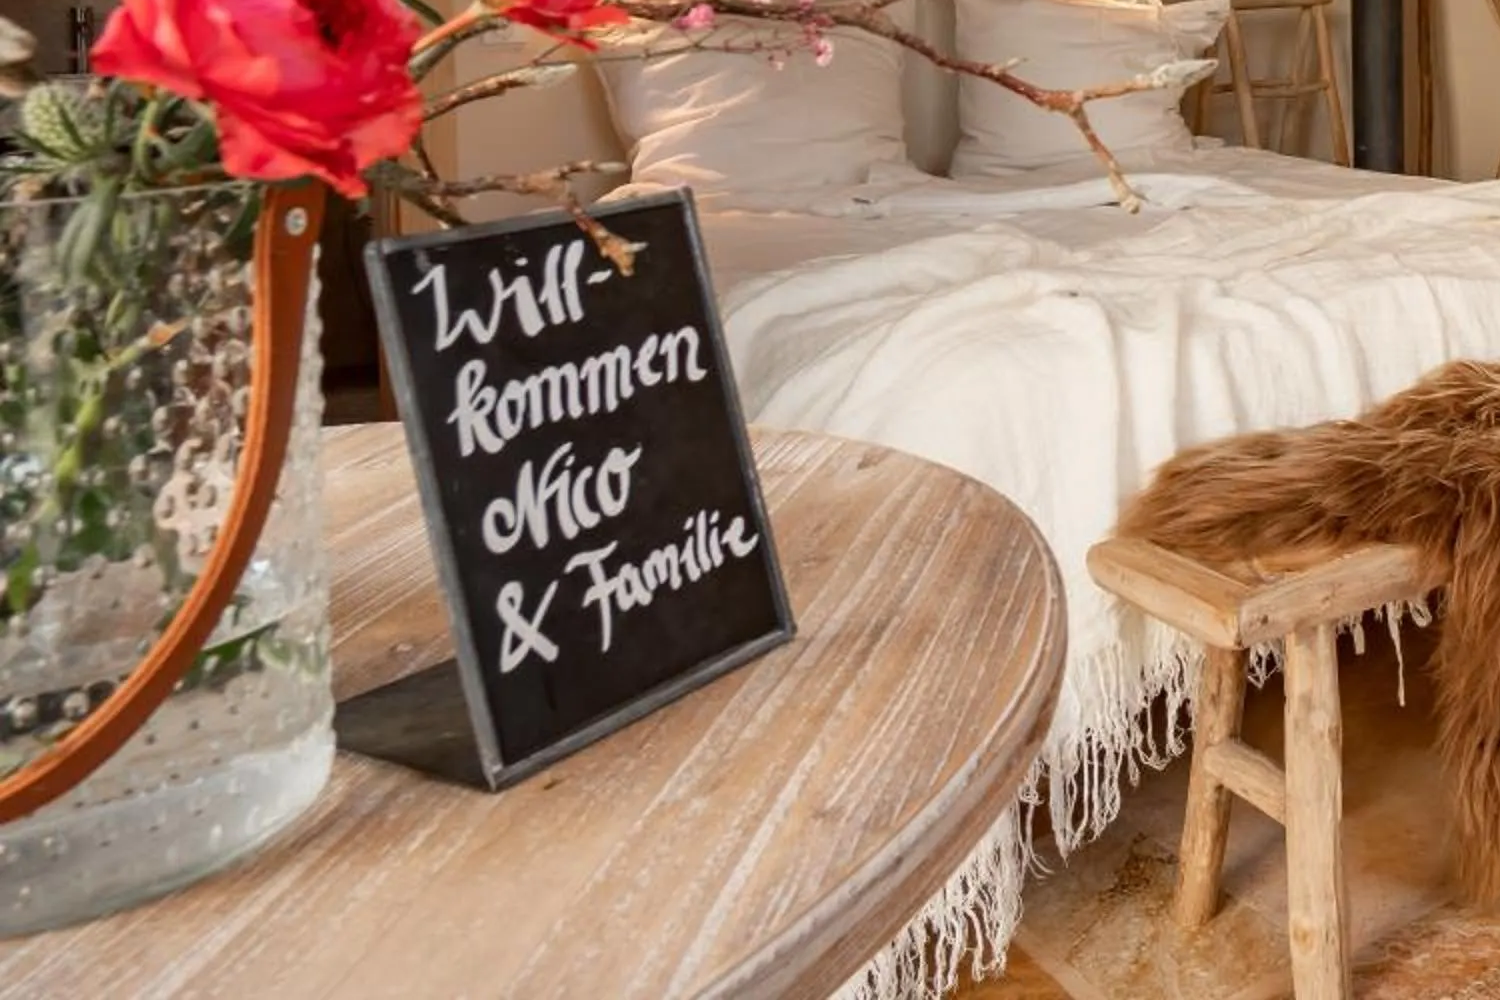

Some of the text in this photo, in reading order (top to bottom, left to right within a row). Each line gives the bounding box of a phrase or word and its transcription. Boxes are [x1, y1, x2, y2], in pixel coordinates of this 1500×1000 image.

[412, 239, 613, 351] Will-
[447, 325, 708, 457] kommen
[482, 441, 642, 554] Nico
[496, 509, 759, 673] & Familie
